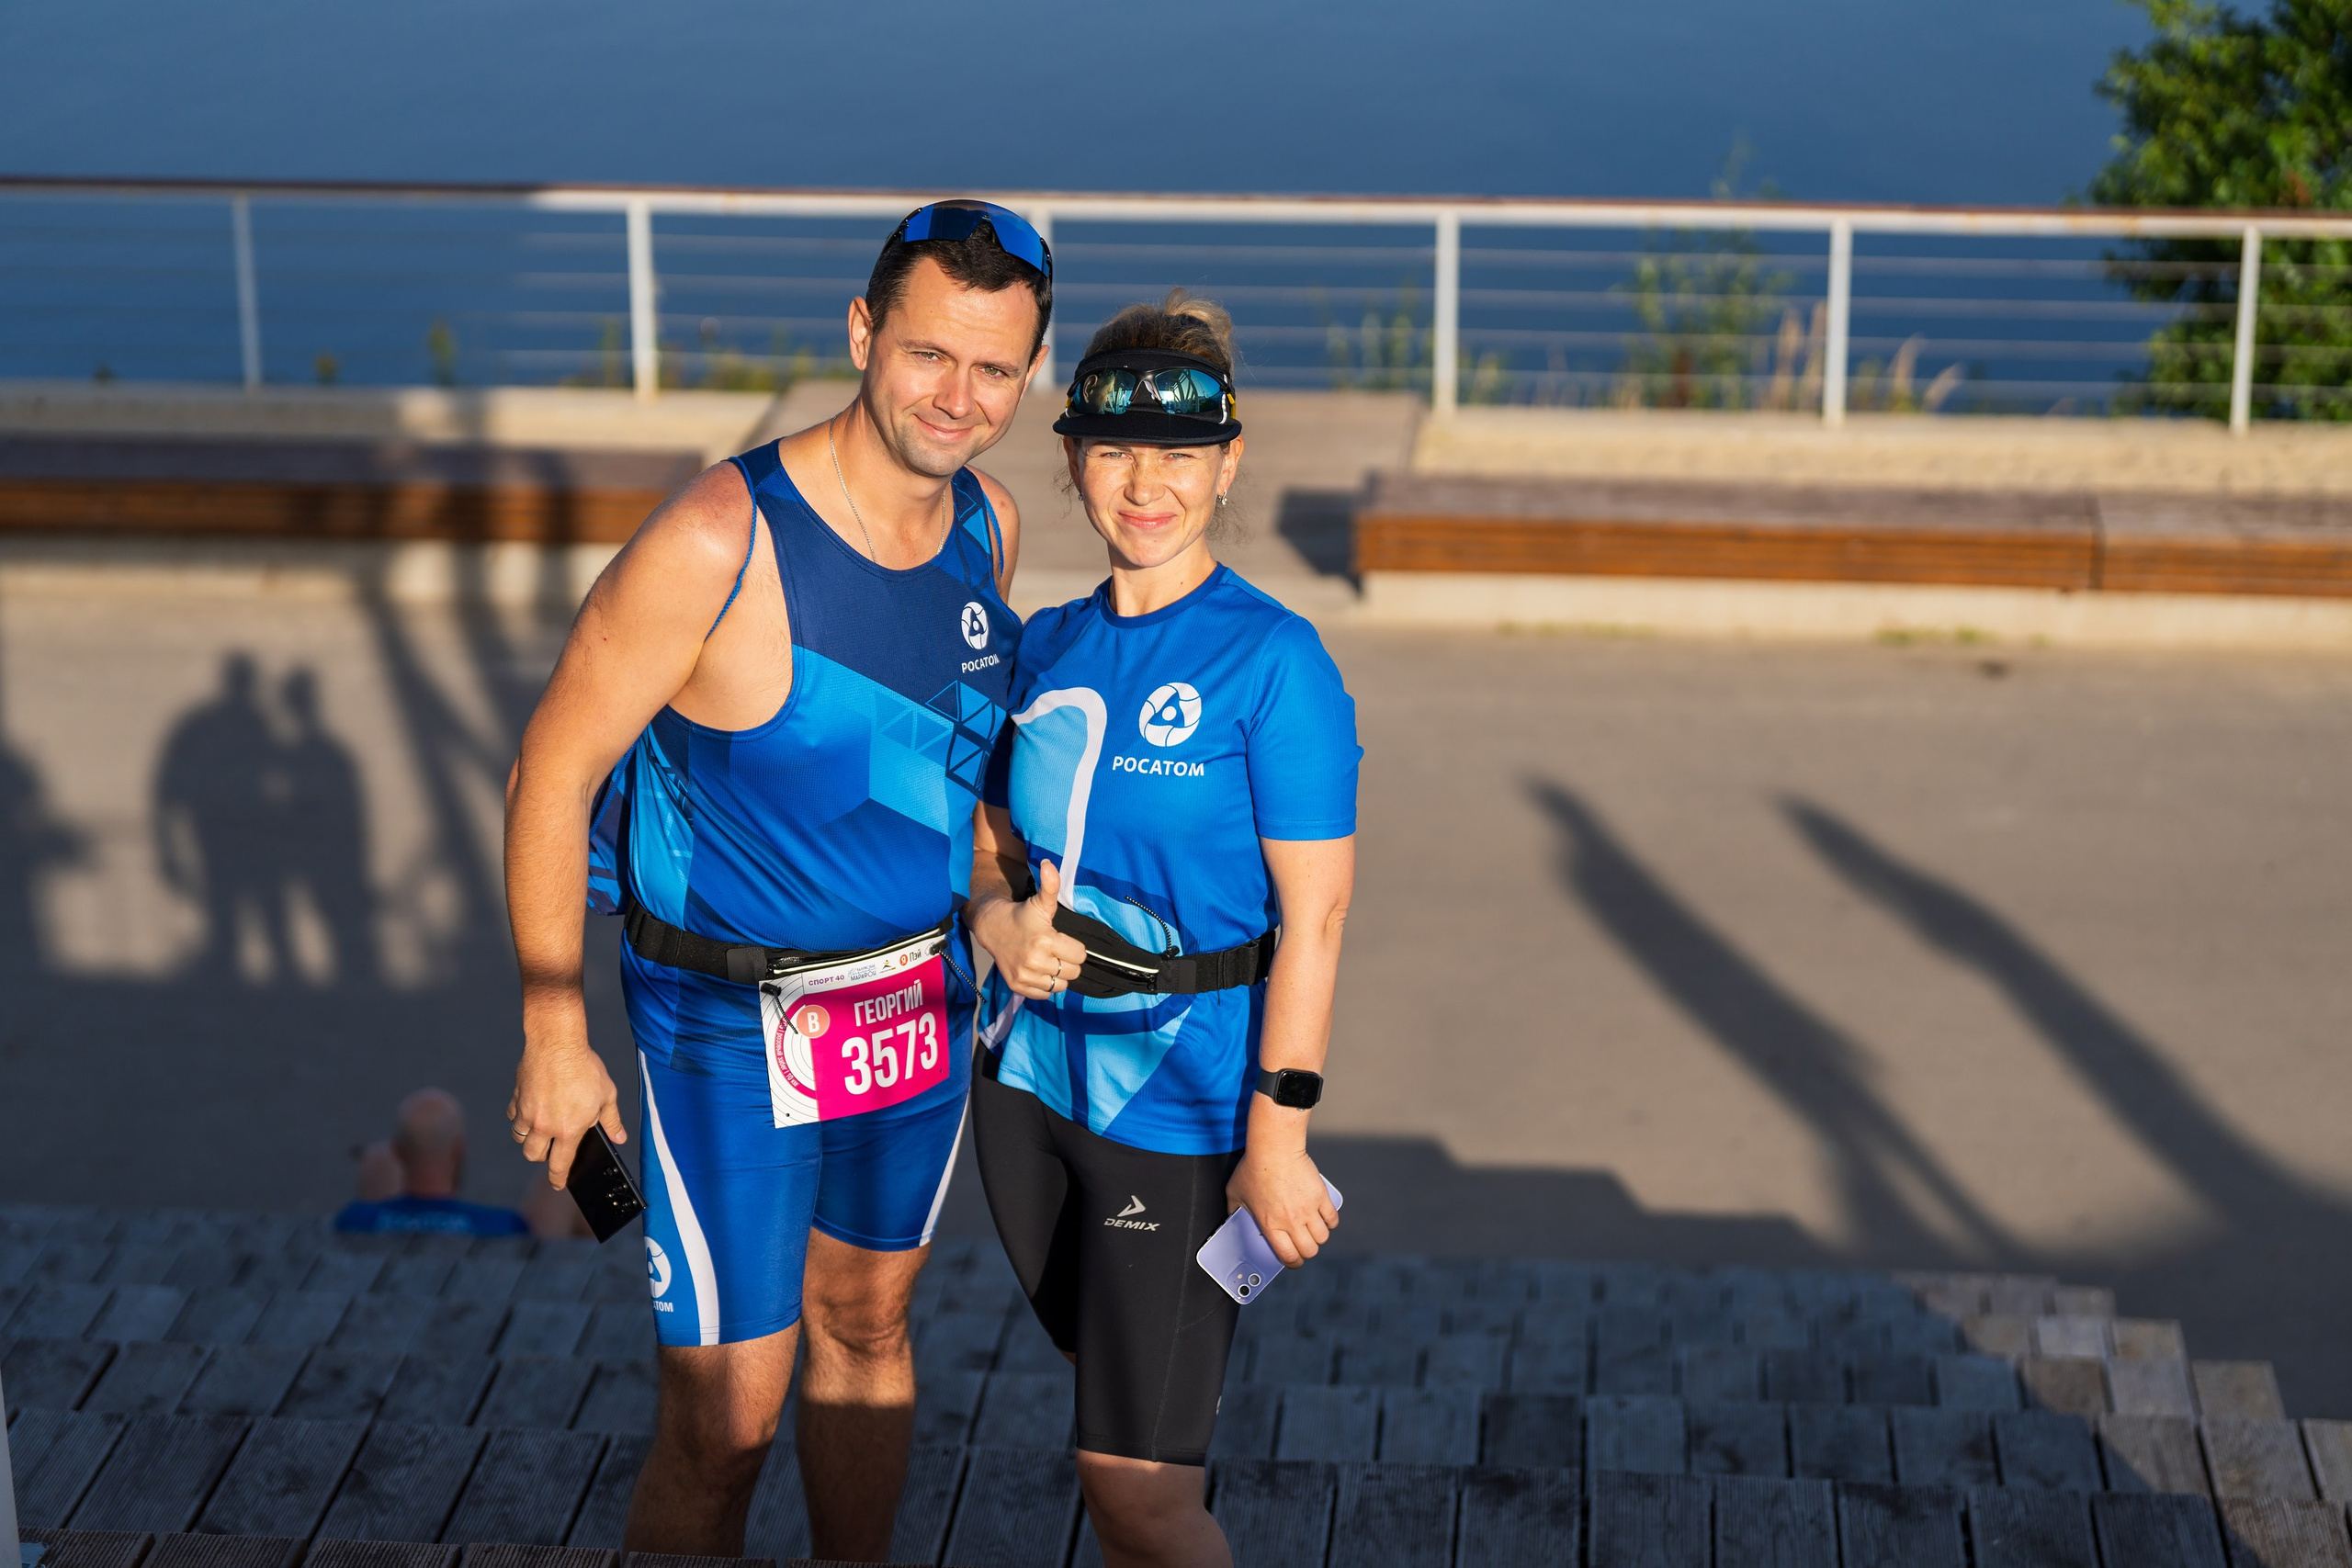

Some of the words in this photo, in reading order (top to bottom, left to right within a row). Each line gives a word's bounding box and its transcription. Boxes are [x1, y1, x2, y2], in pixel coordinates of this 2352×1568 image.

[1112, 755, 1204, 777] РОСАТОМ
[808, 976, 834, 986] СПОРТ
[835, 974, 845, 982] 40
[854, 979, 923, 1027] ГЕОРГИЙ
[842, 1012, 938, 1095] 3573
[1103, 1218, 1160, 1232] DEMIX
